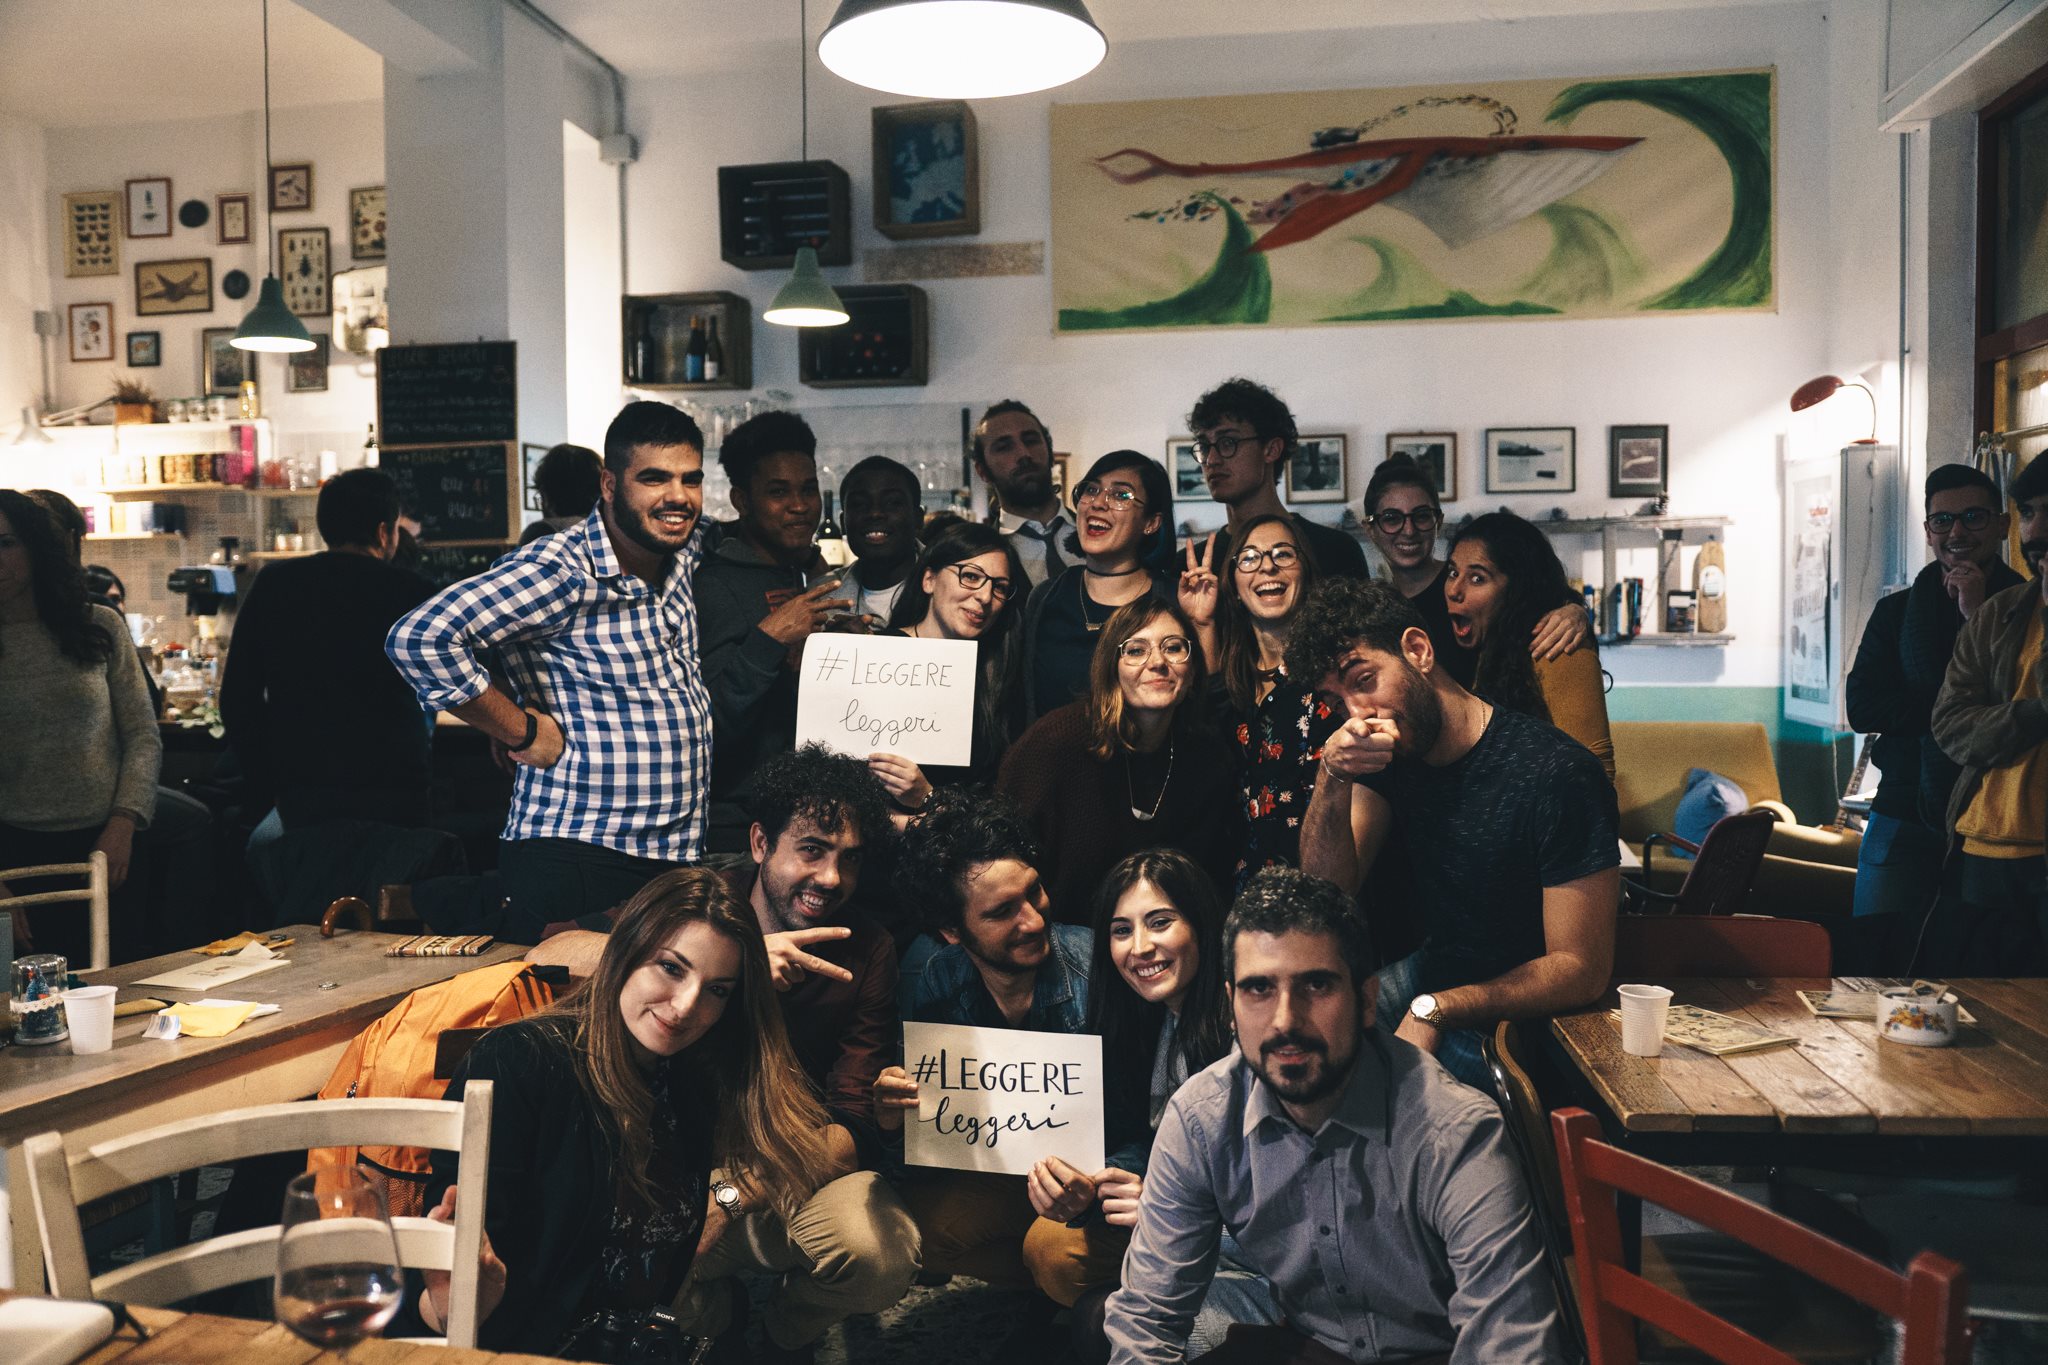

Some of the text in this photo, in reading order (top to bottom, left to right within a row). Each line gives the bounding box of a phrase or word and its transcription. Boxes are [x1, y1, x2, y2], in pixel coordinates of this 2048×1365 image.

[816, 647, 953, 687] #LEGGERE
[839, 698, 942, 747] leggeri
[911, 1048, 1083, 1095] #LEGGERE
[918, 1096, 1069, 1148] leggeri
[655, 1311, 676, 1322] SONY
